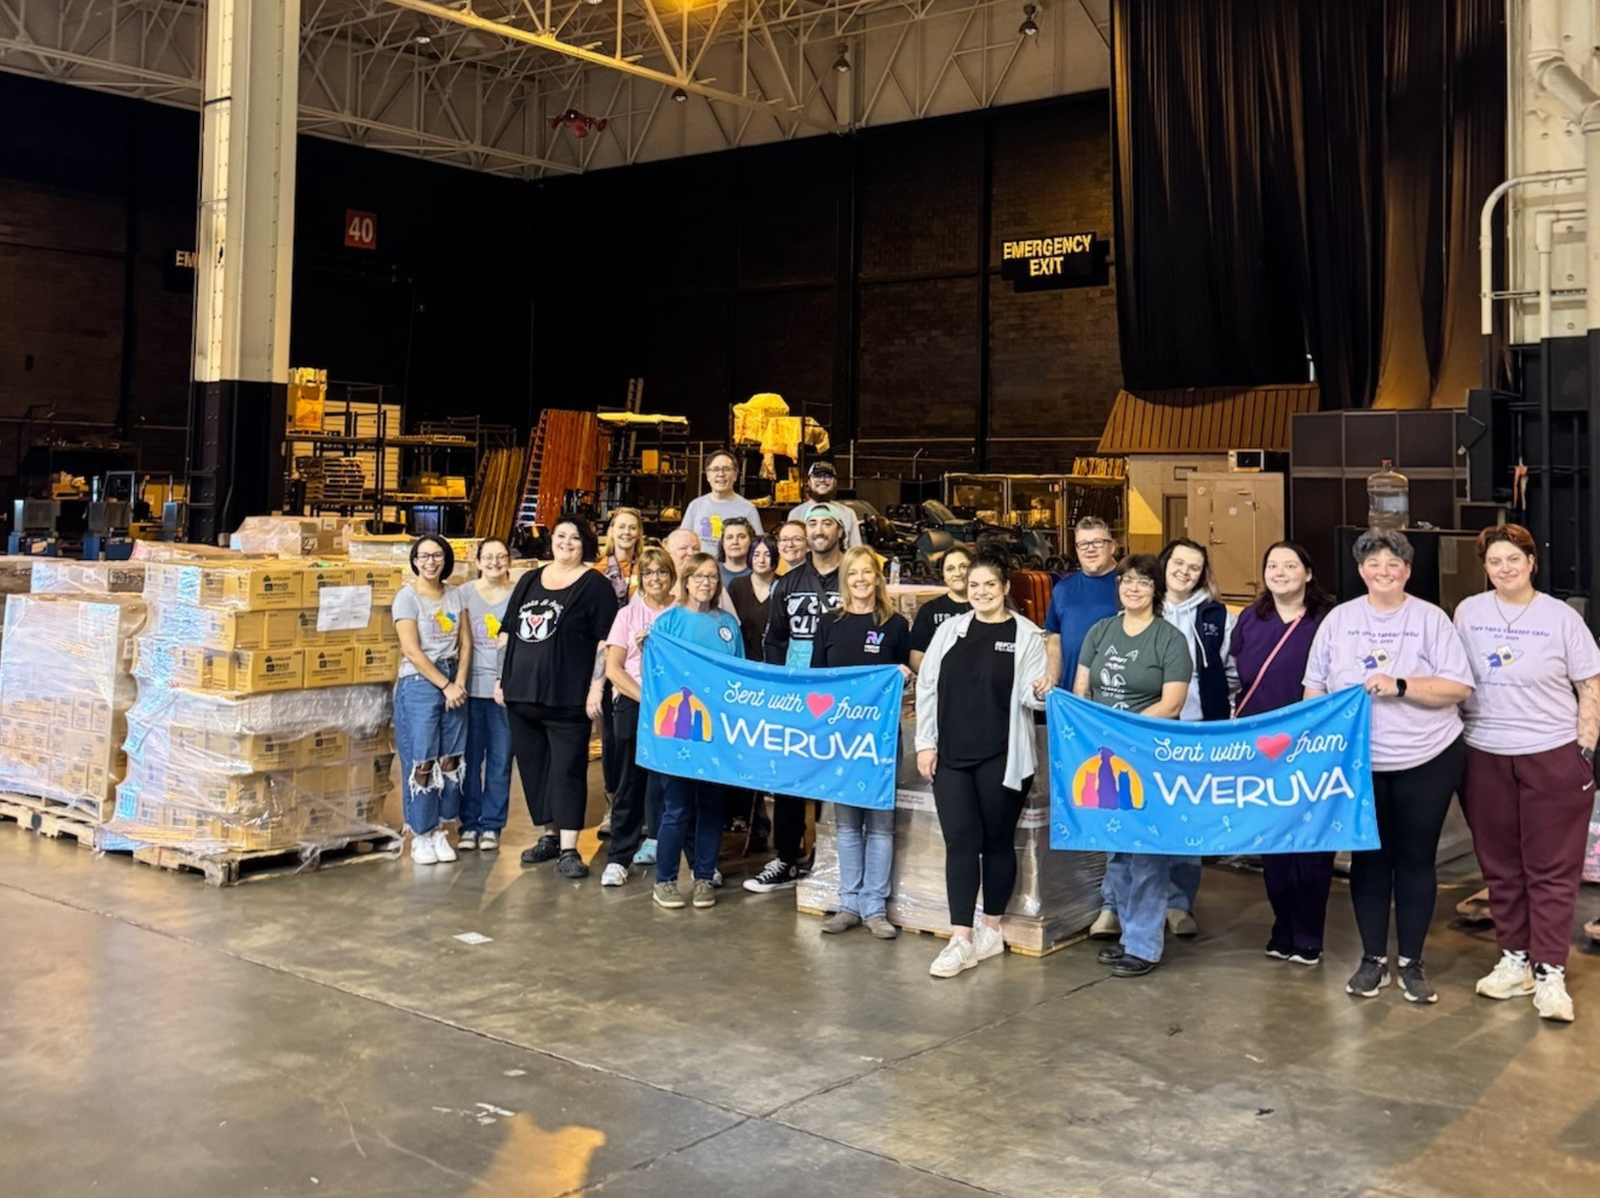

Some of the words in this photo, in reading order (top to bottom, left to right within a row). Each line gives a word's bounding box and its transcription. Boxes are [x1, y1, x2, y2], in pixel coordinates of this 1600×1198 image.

[349, 216, 373, 243] 40
[1003, 233, 1093, 260] EMERGENCY
[1029, 256, 1064, 277] EXIT
[723, 680, 766, 707] Sent
[767, 693, 804, 713] with
[828, 696, 882, 725] from
[719, 711, 879, 766] WERUVA
[1153, 736, 1205, 762] Sent
[1210, 741, 1256, 762] with
[1286, 730, 1348, 763] from
[1152, 765, 1355, 809] WERUVA
